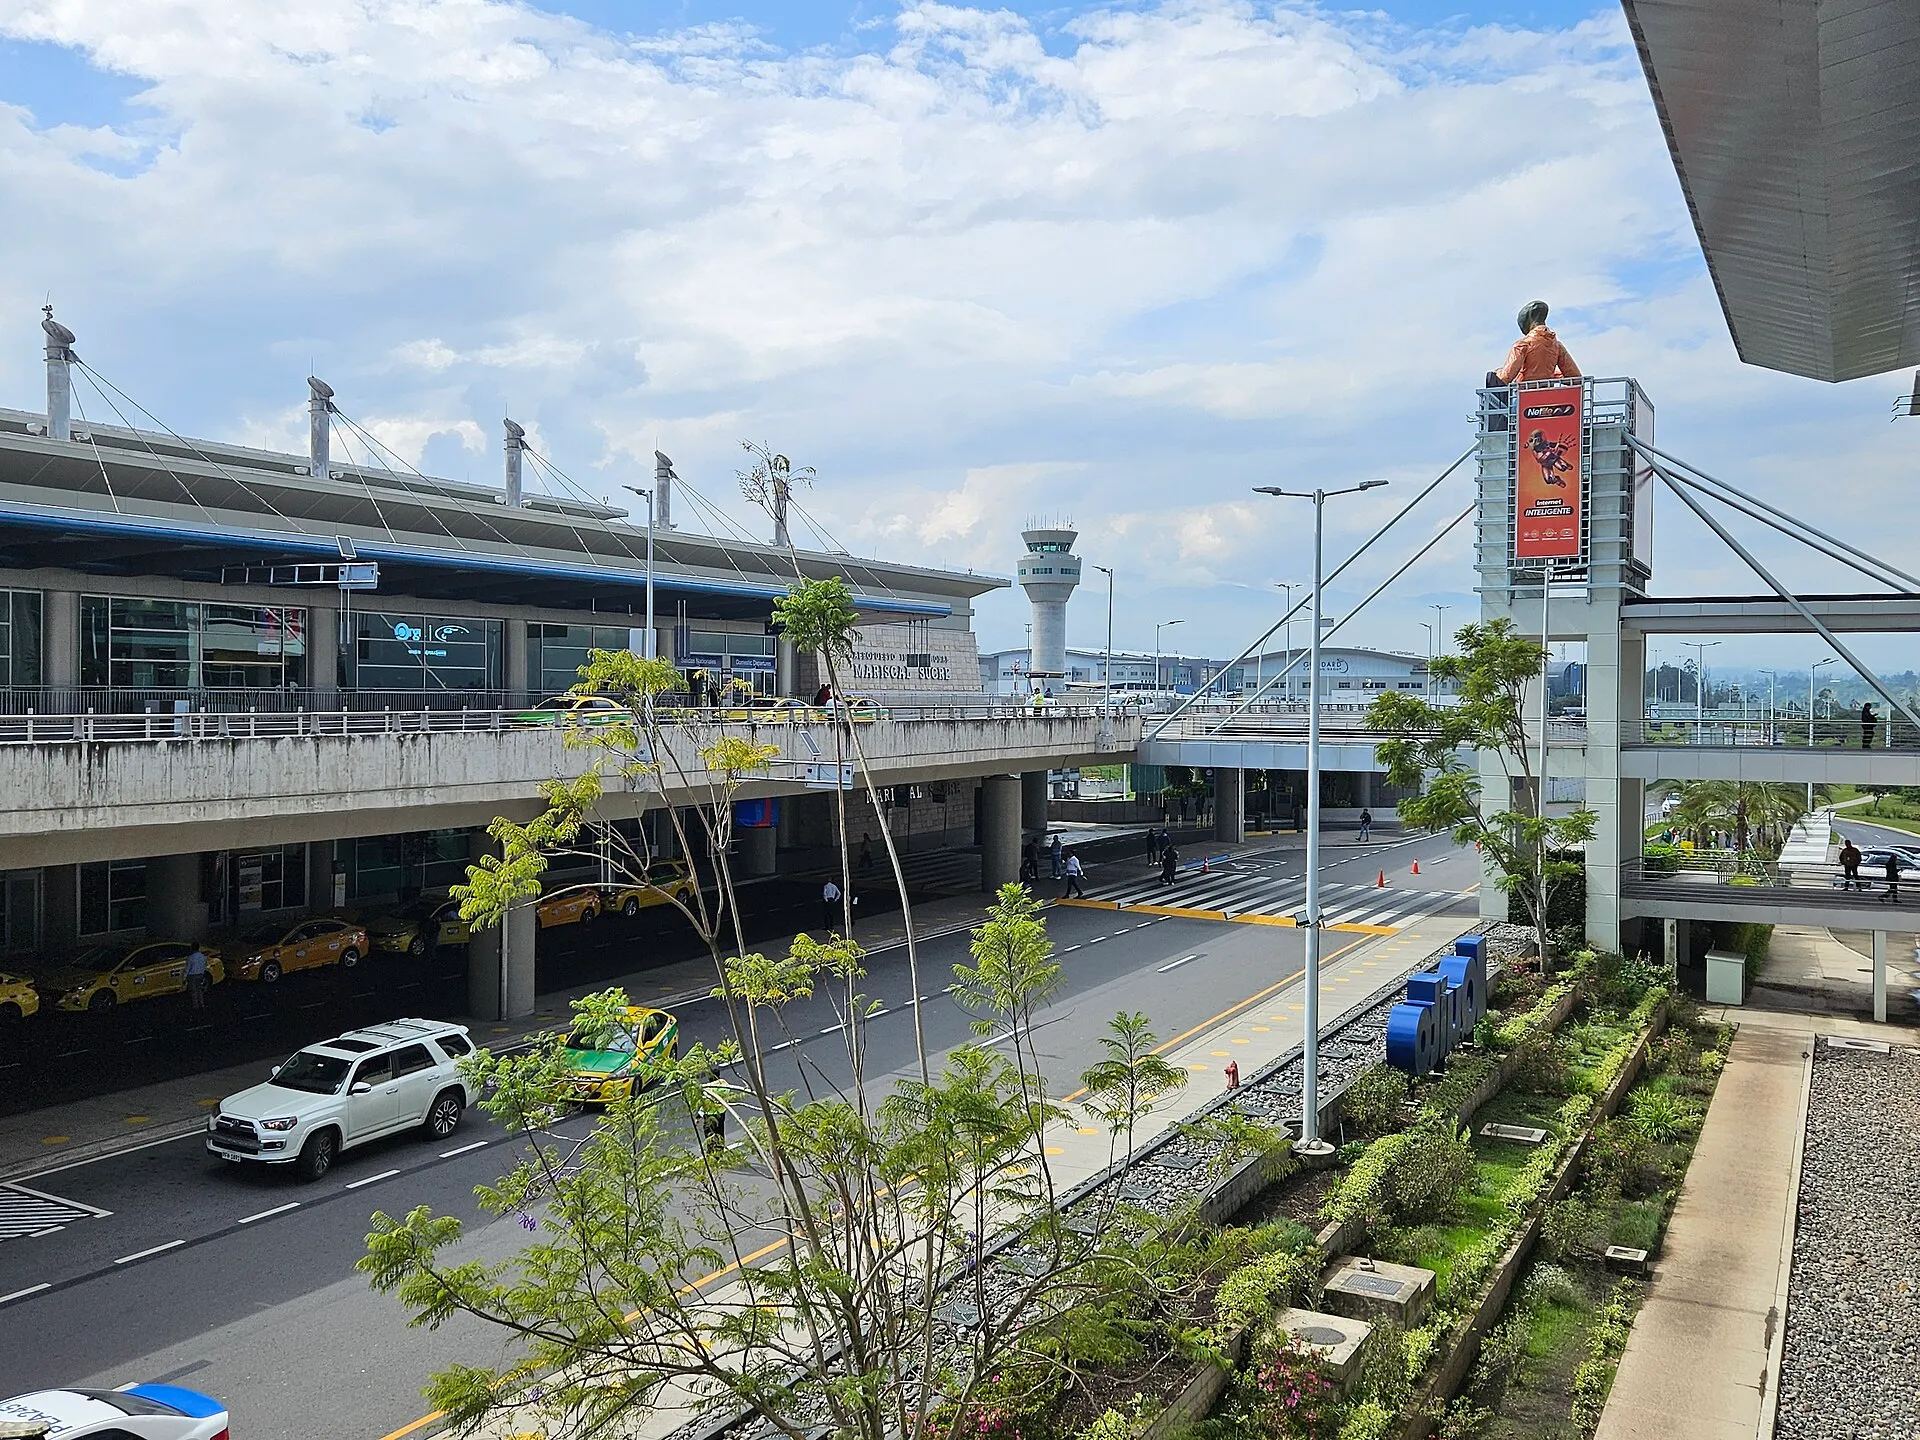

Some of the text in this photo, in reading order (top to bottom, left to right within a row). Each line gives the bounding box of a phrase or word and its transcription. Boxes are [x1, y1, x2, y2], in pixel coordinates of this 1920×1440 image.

[1525, 507, 1571, 517] INTELIGENTE
[736, 658, 753, 666] Domestic
[853, 664, 951, 680] MARISCAL SUCRE
[866, 785, 922, 804] MARIAL
